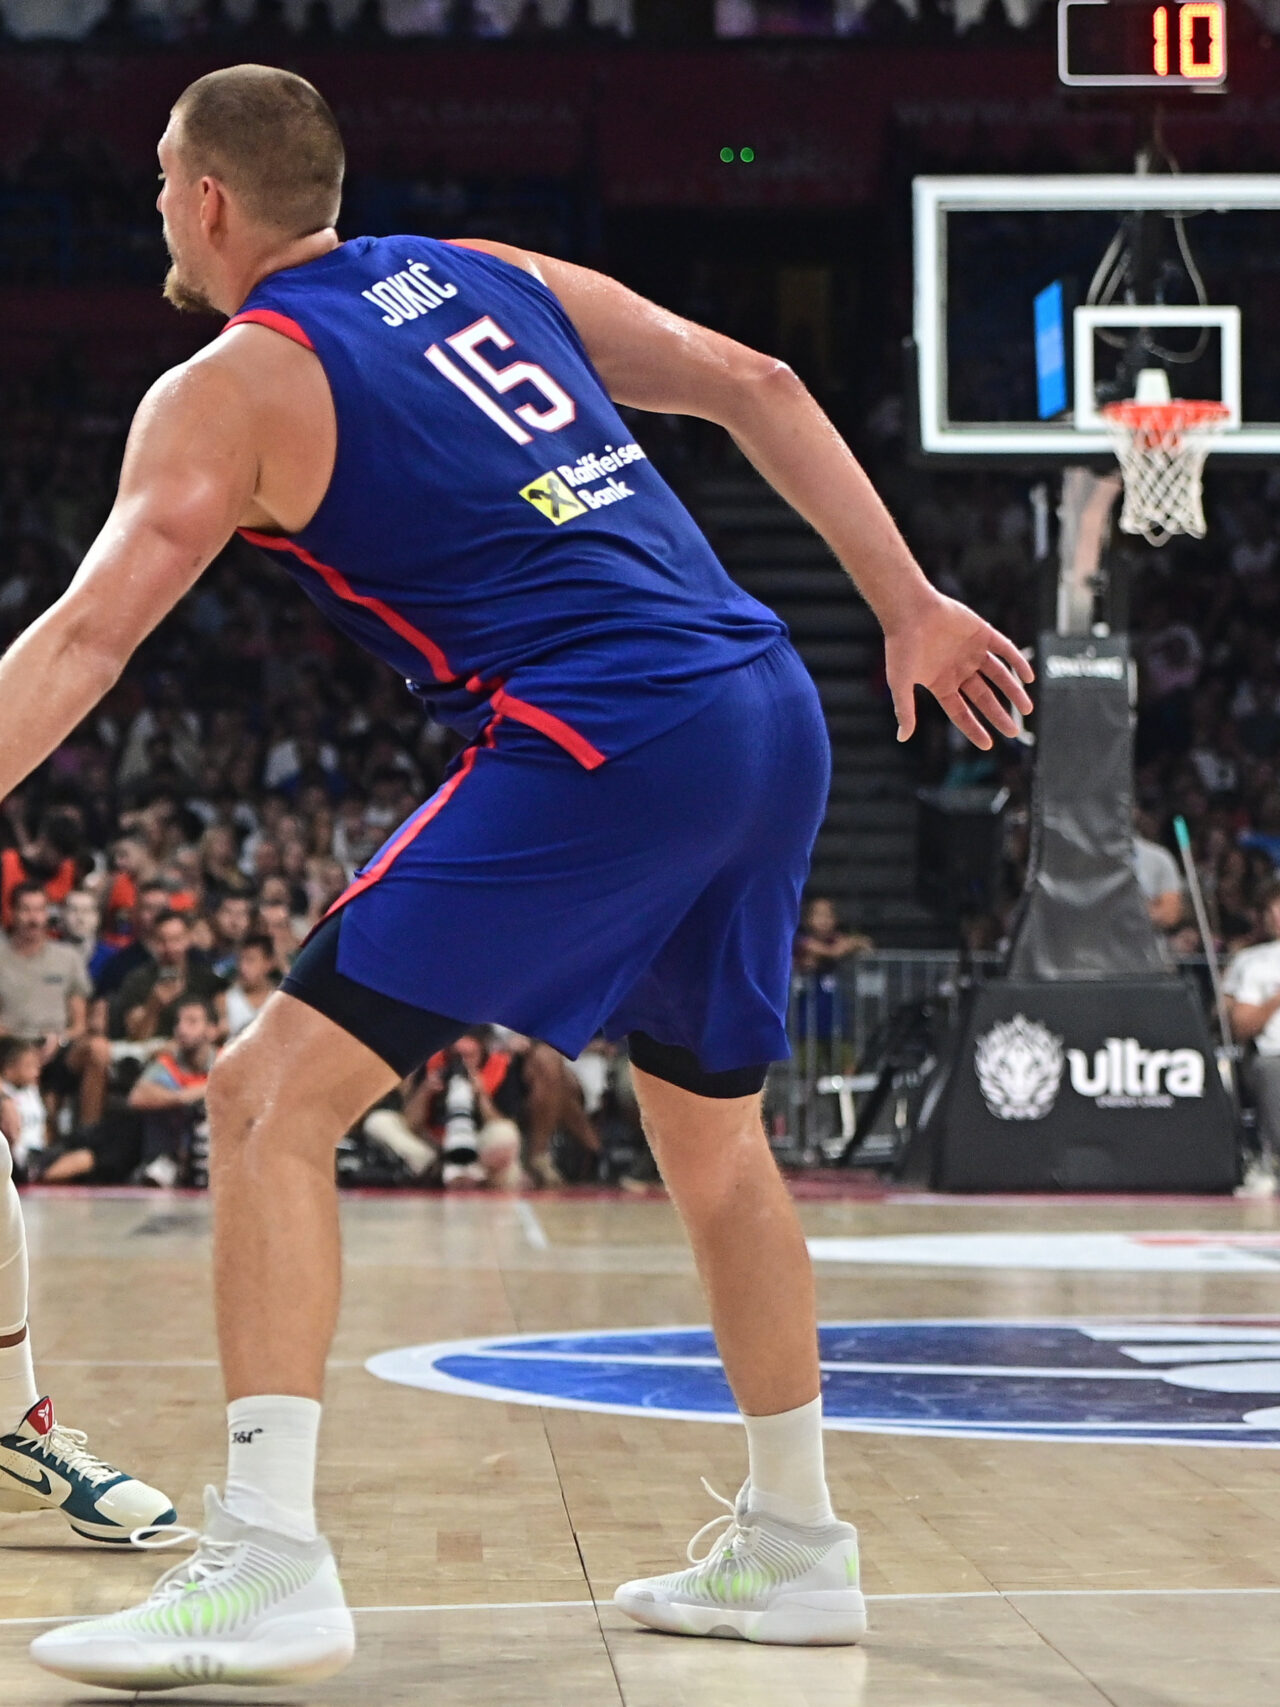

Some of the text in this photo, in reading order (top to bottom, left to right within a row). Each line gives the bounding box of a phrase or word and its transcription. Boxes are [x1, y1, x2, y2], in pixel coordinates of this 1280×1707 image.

[1152, 3, 1224, 78] 10
[361, 258, 458, 327] JOKIĆ
[424, 315, 576, 446] 15
[577, 477, 635, 509] Bank
[1066, 1037, 1205, 1098] ultra
